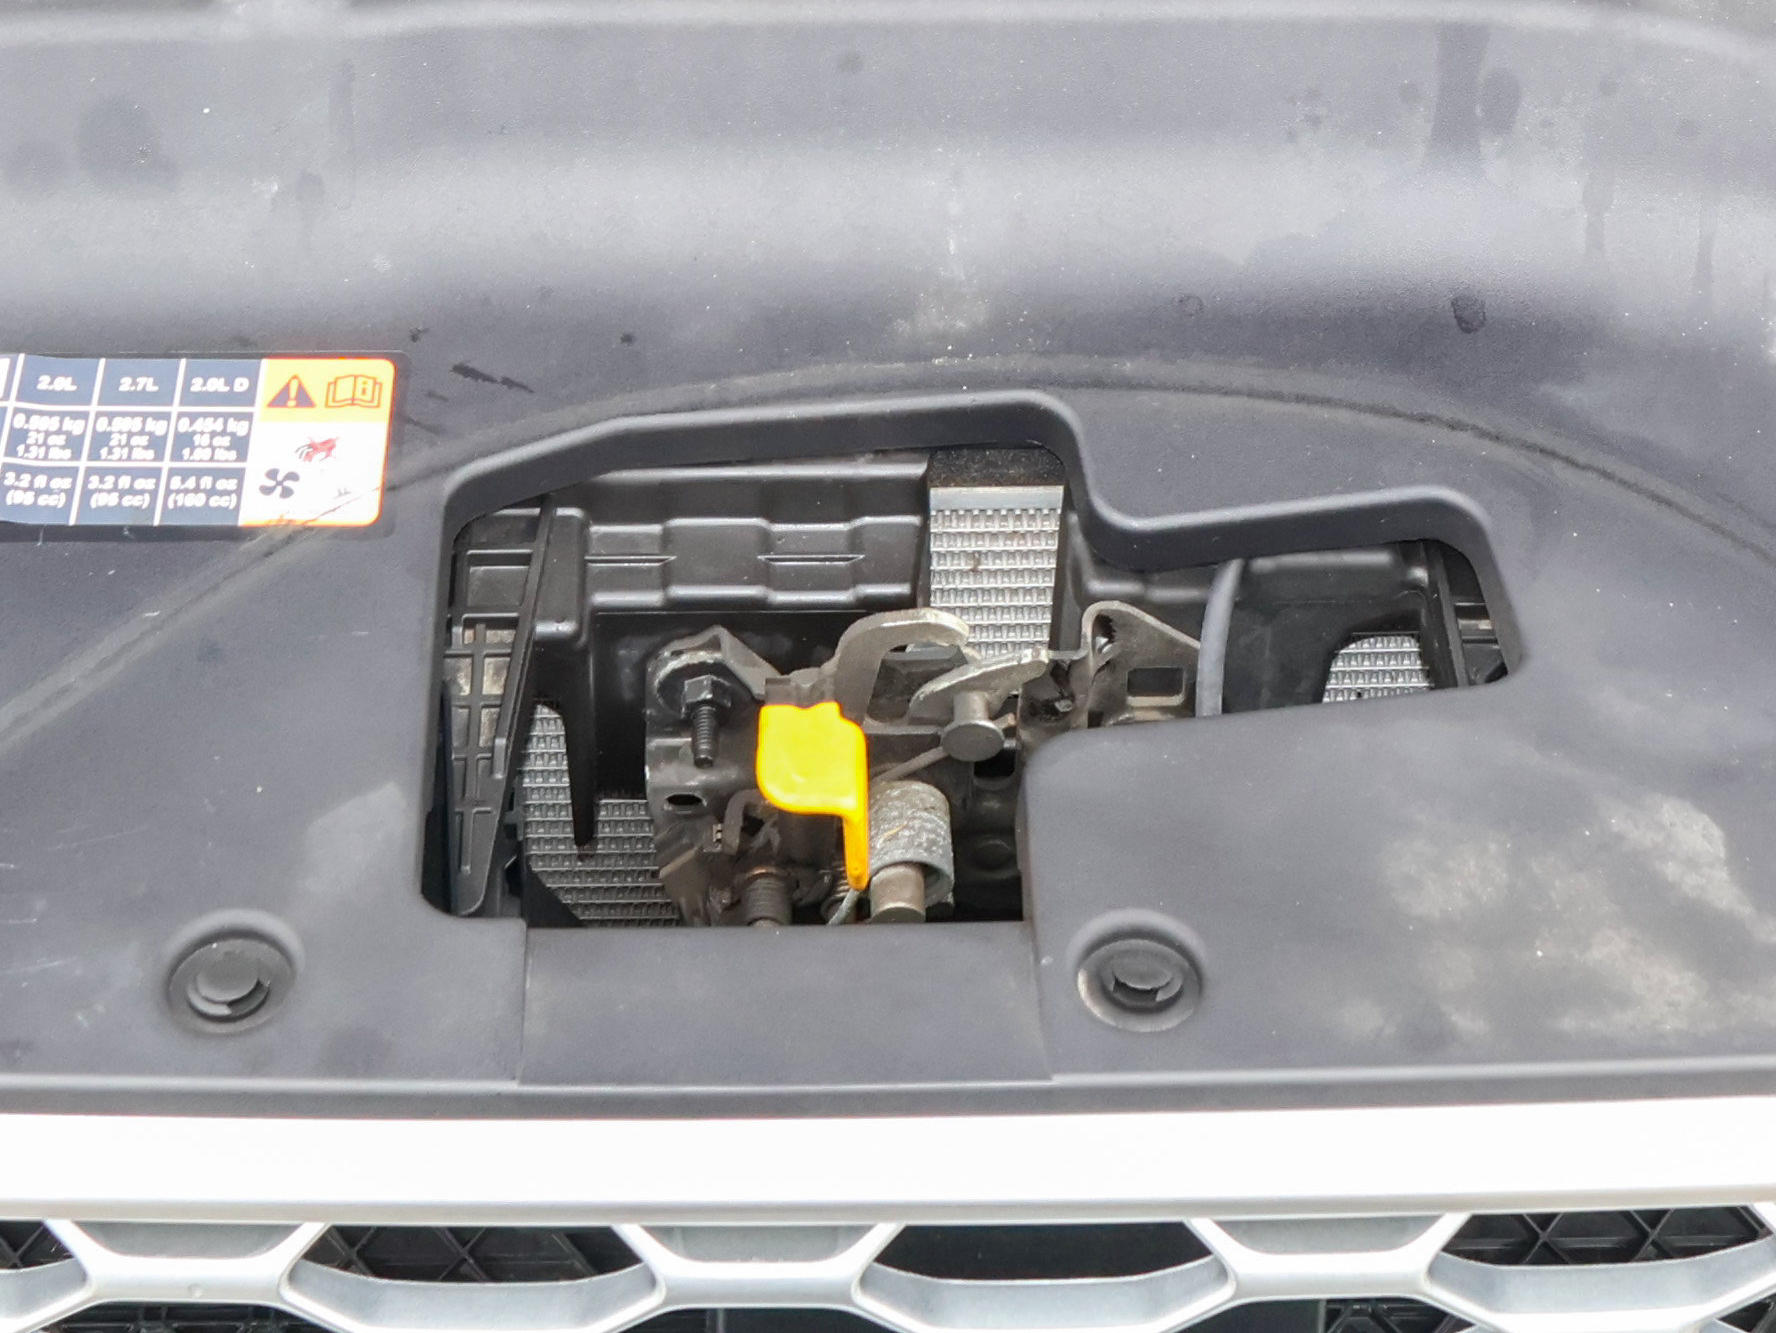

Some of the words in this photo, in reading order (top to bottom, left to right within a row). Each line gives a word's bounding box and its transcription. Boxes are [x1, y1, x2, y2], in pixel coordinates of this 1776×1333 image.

[35, 374, 78, 392] 2.0L
[117, 376, 160, 393] 2.7L
[232, 376, 250, 393] D
[62, 415, 86, 436] kg
[144, 417, 169, 437] kg
[226, 417, 251, 438] kg
